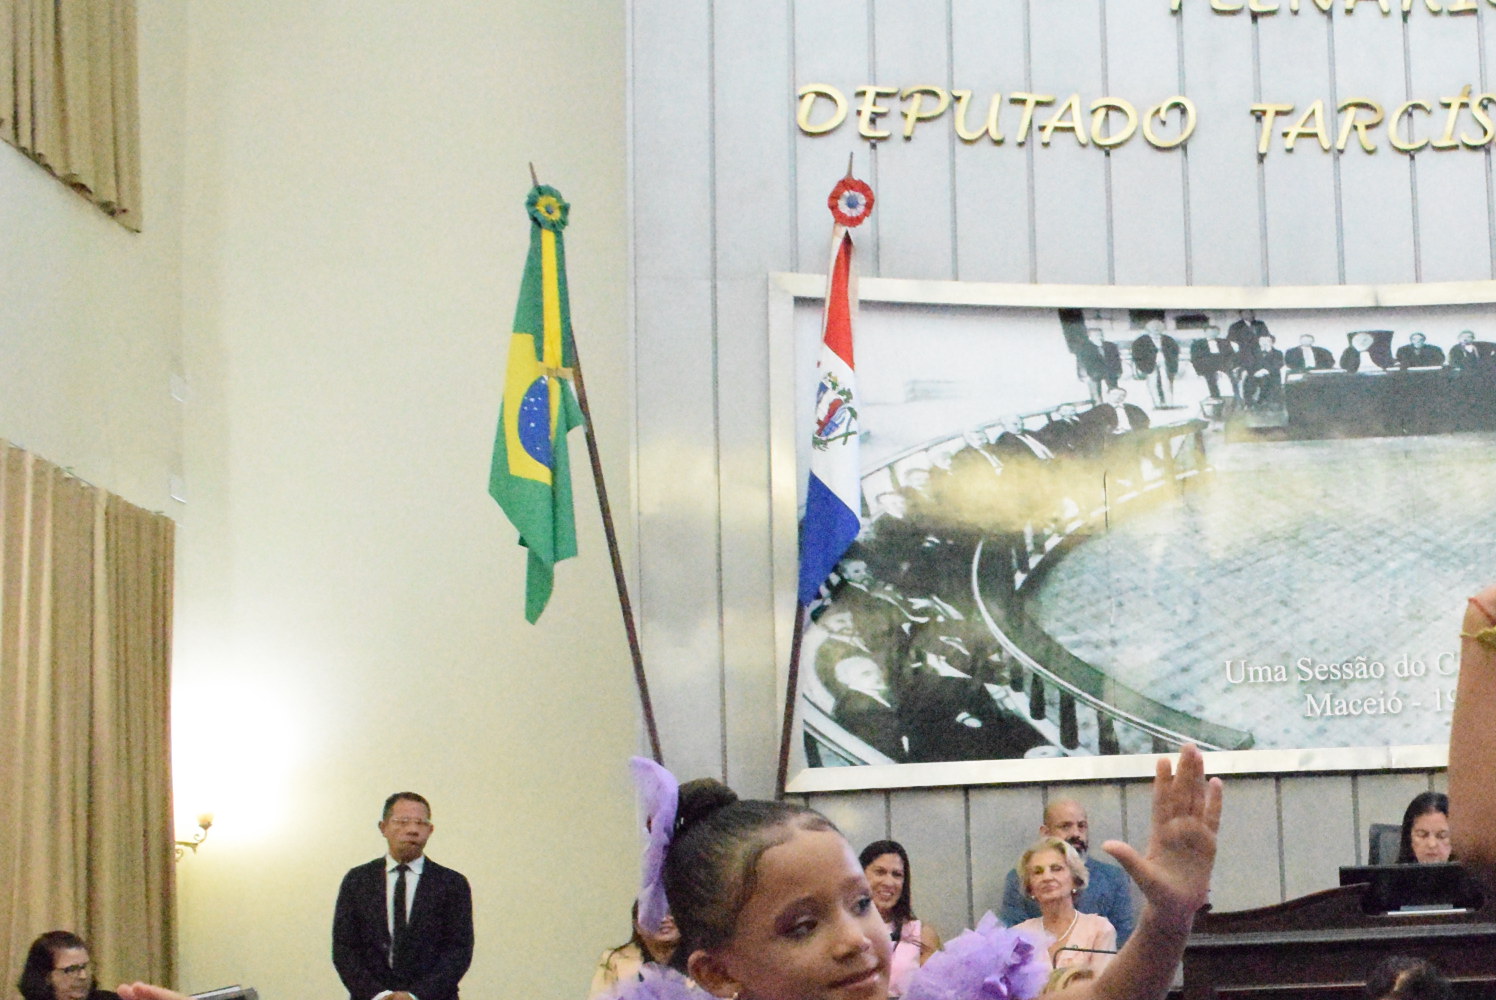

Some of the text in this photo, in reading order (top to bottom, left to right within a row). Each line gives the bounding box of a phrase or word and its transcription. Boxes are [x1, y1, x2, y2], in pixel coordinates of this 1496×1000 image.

[796, 83, 1197, 148] DEPUTADO
[1224, 659, 1288, 684] Uma
[1296, 656, 1386, 682] Sessão
[1394, 652, 1427, 678] do
[1304, 690, 1403, 718] Maceió
